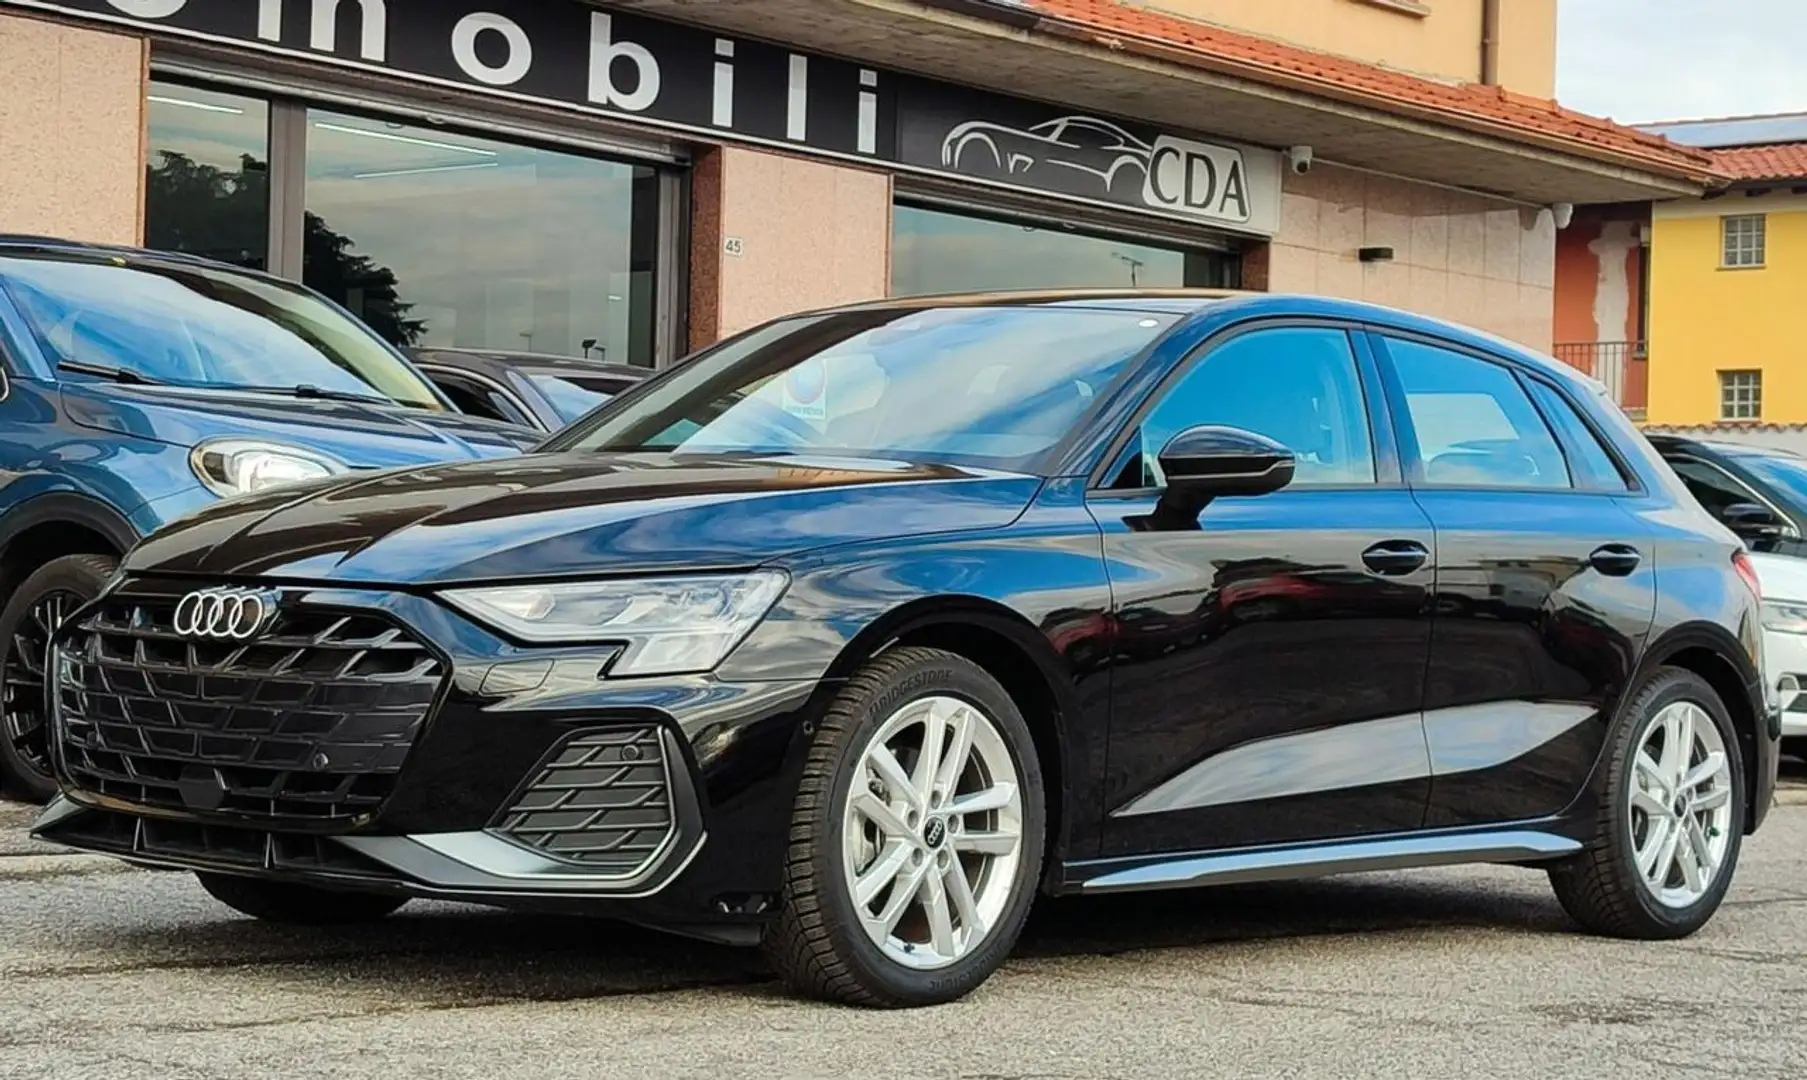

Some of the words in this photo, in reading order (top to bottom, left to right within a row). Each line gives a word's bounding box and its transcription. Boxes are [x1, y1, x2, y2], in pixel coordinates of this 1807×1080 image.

[105, 0, 877, 154] mobili
[1150, 146, 1247, 217] CDA
[726, 239, 741, 253] 45
